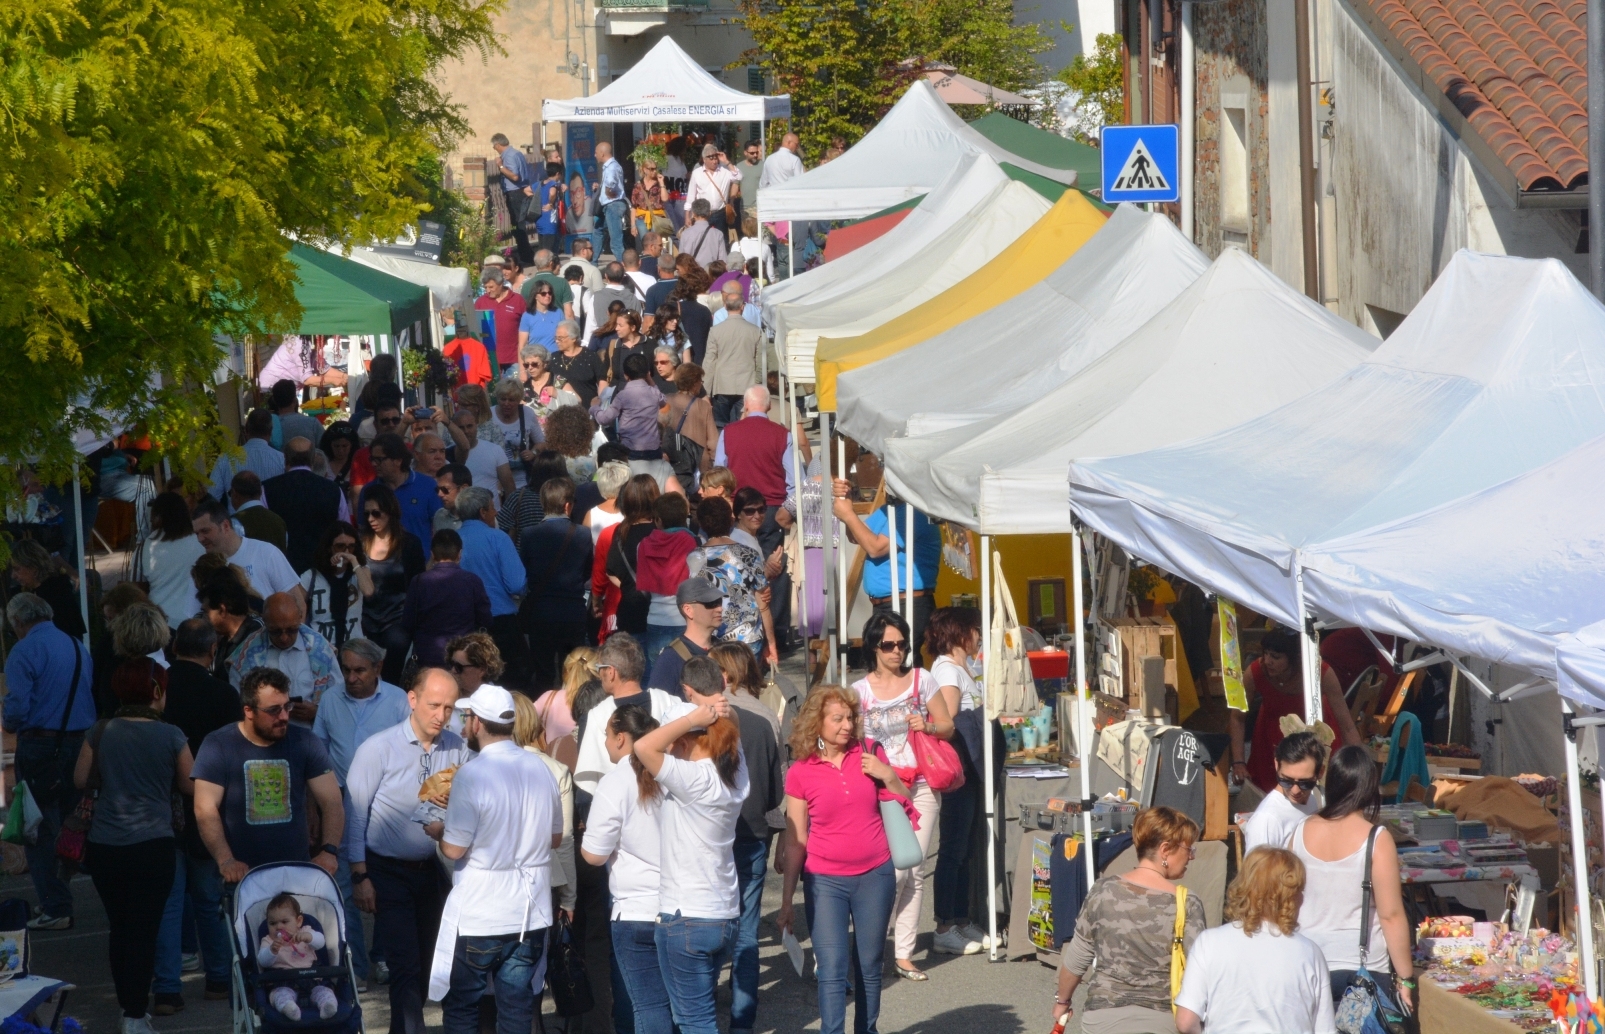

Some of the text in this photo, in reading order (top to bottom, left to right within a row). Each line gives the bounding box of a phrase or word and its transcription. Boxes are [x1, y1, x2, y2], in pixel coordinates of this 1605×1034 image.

[574, 104, 737, 116] Azienda Multiservizi Casalese ENERGIA srl
[1179, 734, 1197, 750] L'OR
[1177, 746, 1196, 763] AGE
